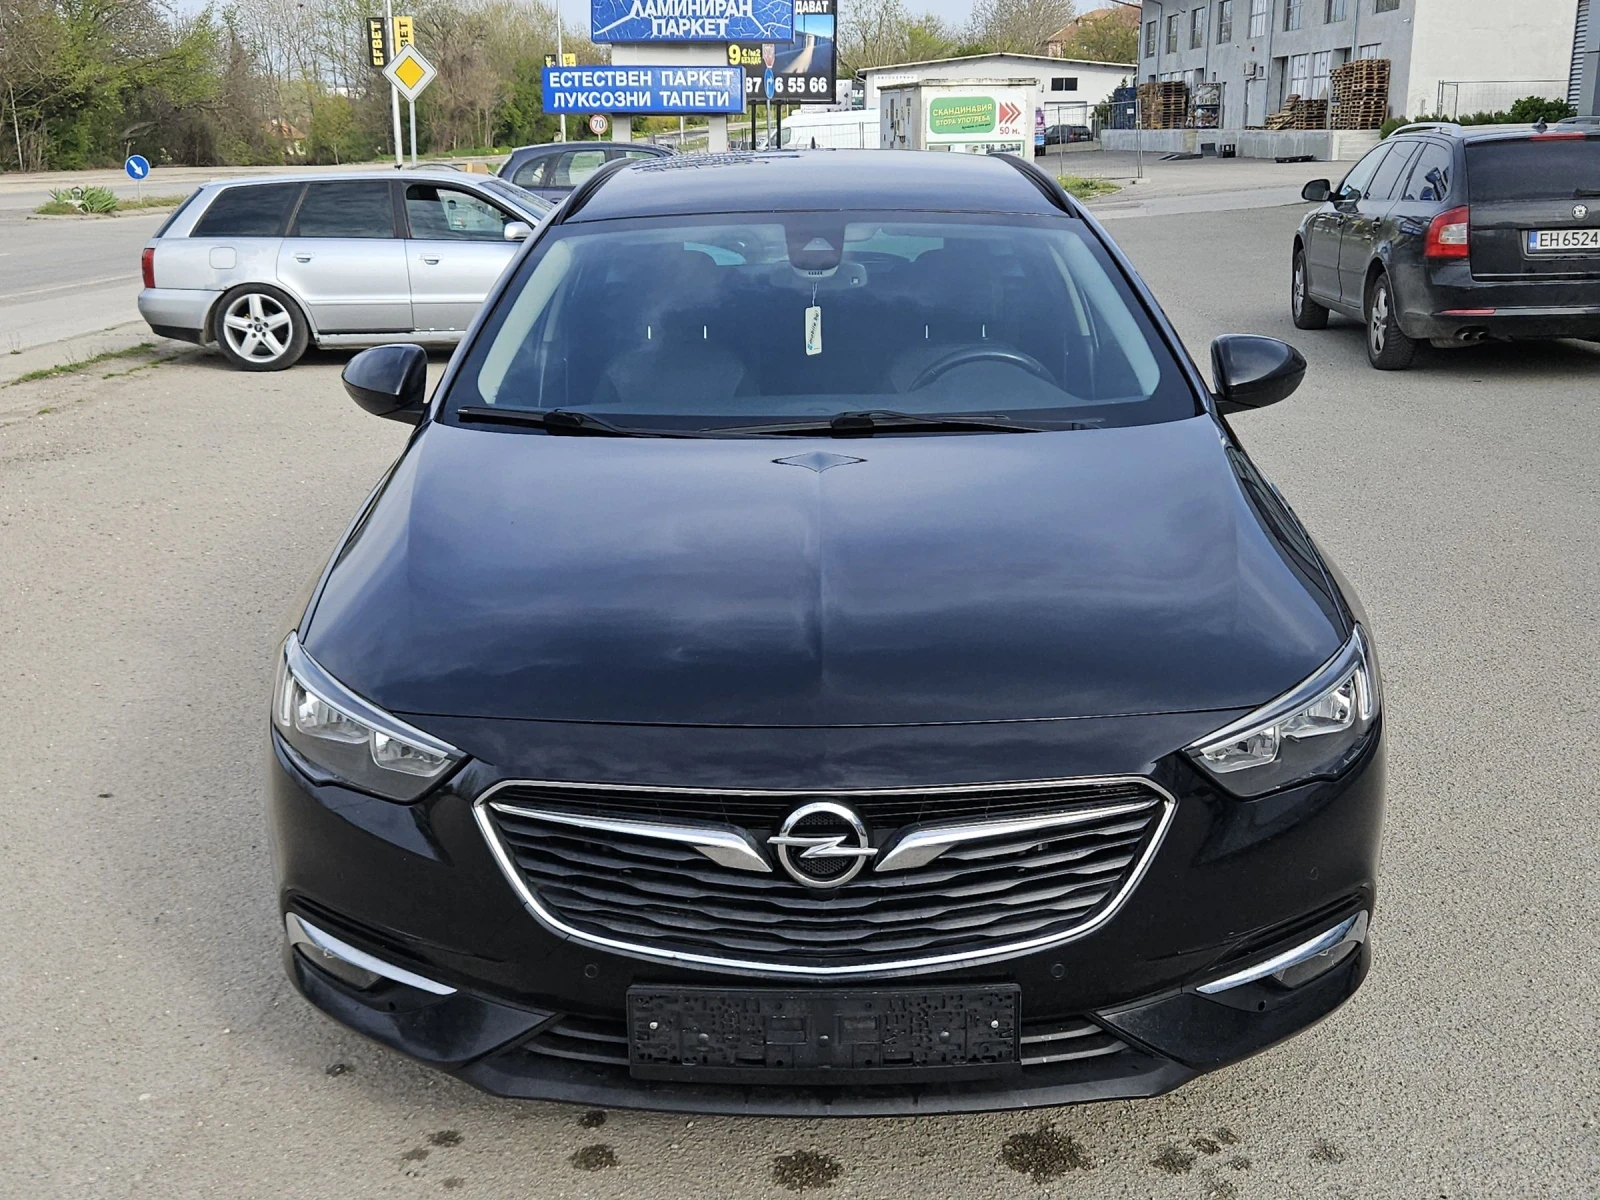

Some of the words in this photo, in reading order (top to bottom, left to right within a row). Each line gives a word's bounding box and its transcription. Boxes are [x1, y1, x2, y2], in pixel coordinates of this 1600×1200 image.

[628, 0, 753, 17] ЛАМИНИРАН
[651, 18, 730, 36] ПАРКЕТ
[371, 20, 384, 66] EFBET
[728, 44, 741, 65] 9
[549, 71, 651, 88] ЕСТЕСТВЕН
[661, 70, 734, 86] ПАРКЕТ
[787, 76, 806, 93] 55
[809, 76, 827, 93] 66
[553, 91, 651, 107] ЛУКСОЗНИ
[659, 90, 730, 107] ТАПЕТИ
[932, 103, 993, 116] СКАНДИНАВИЯ
[593, 119, 604, 129] 70
[935, 118, 956, 127] ВТОРА
[957, 115, 991, 125] УПОТРЕБА
[999, 126, 1010, 135] 50
[1540, 232, 1559, 247] EH
[1562, 231, 1599, 247] 6524
